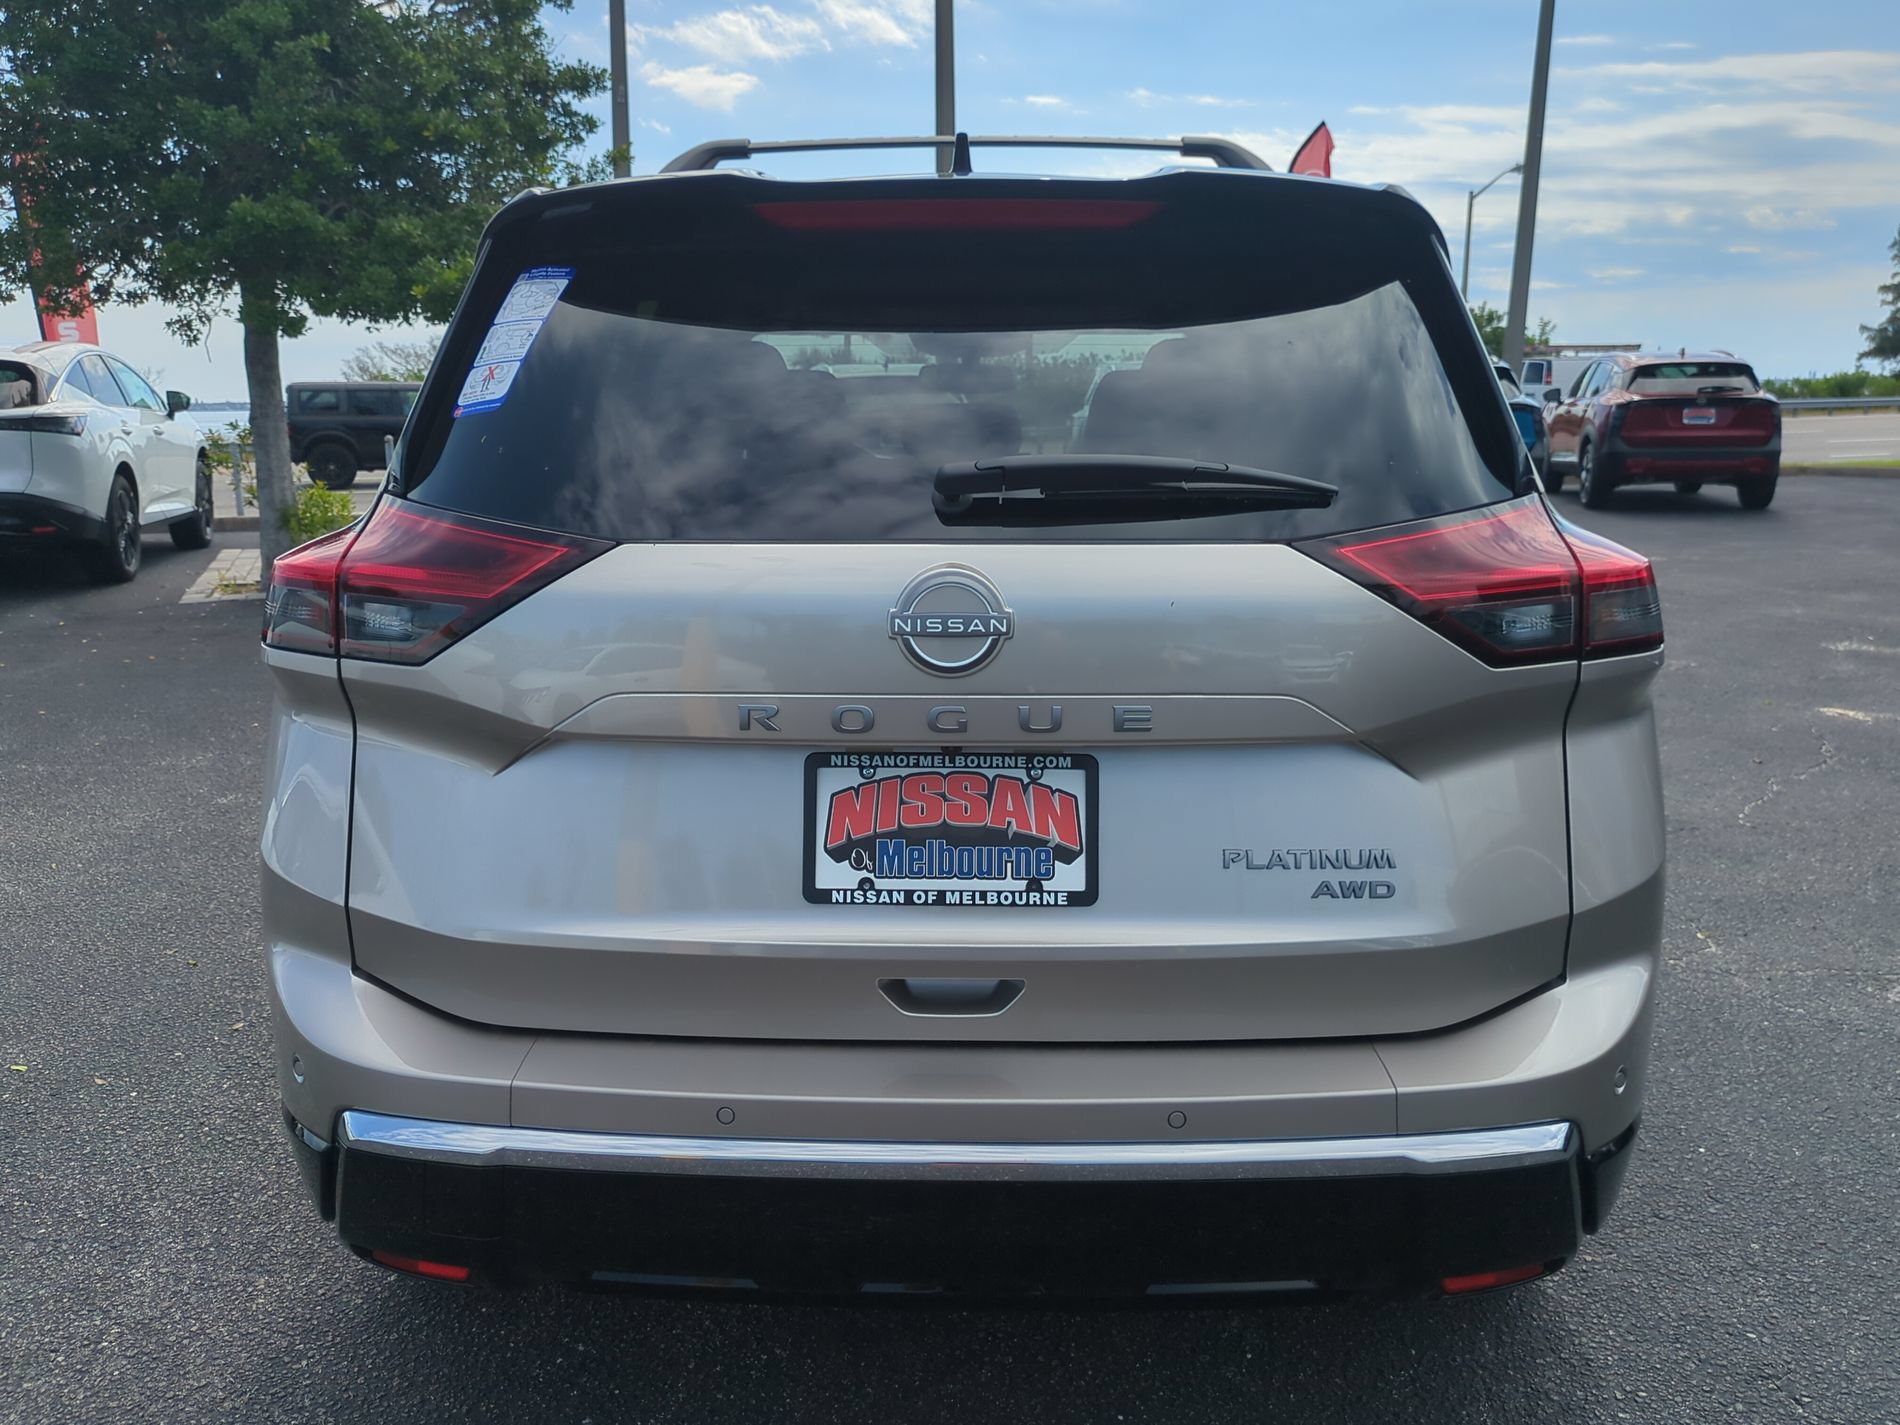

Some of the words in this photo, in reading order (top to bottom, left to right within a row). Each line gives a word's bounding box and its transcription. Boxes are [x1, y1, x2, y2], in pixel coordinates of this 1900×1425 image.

[894, 618, 1008, 633] NISSAN
[738, 704, 1153, 734] ROGUE
[830, 755, 1072, 768] NISSANOFMELBOURNE.COM
[826, 773, 1082, 850] NISSAN
[876, 838, 1053, 878] Melbourne
[1222, 849, 1397, 870] PLATINUM
[832, 890, 904, 904] NISSAN
[913, 891, 938, 904] OF
[945, 891, 1068, 905] MELBOURNE
[1310, 880, 1396, 899] AWD
